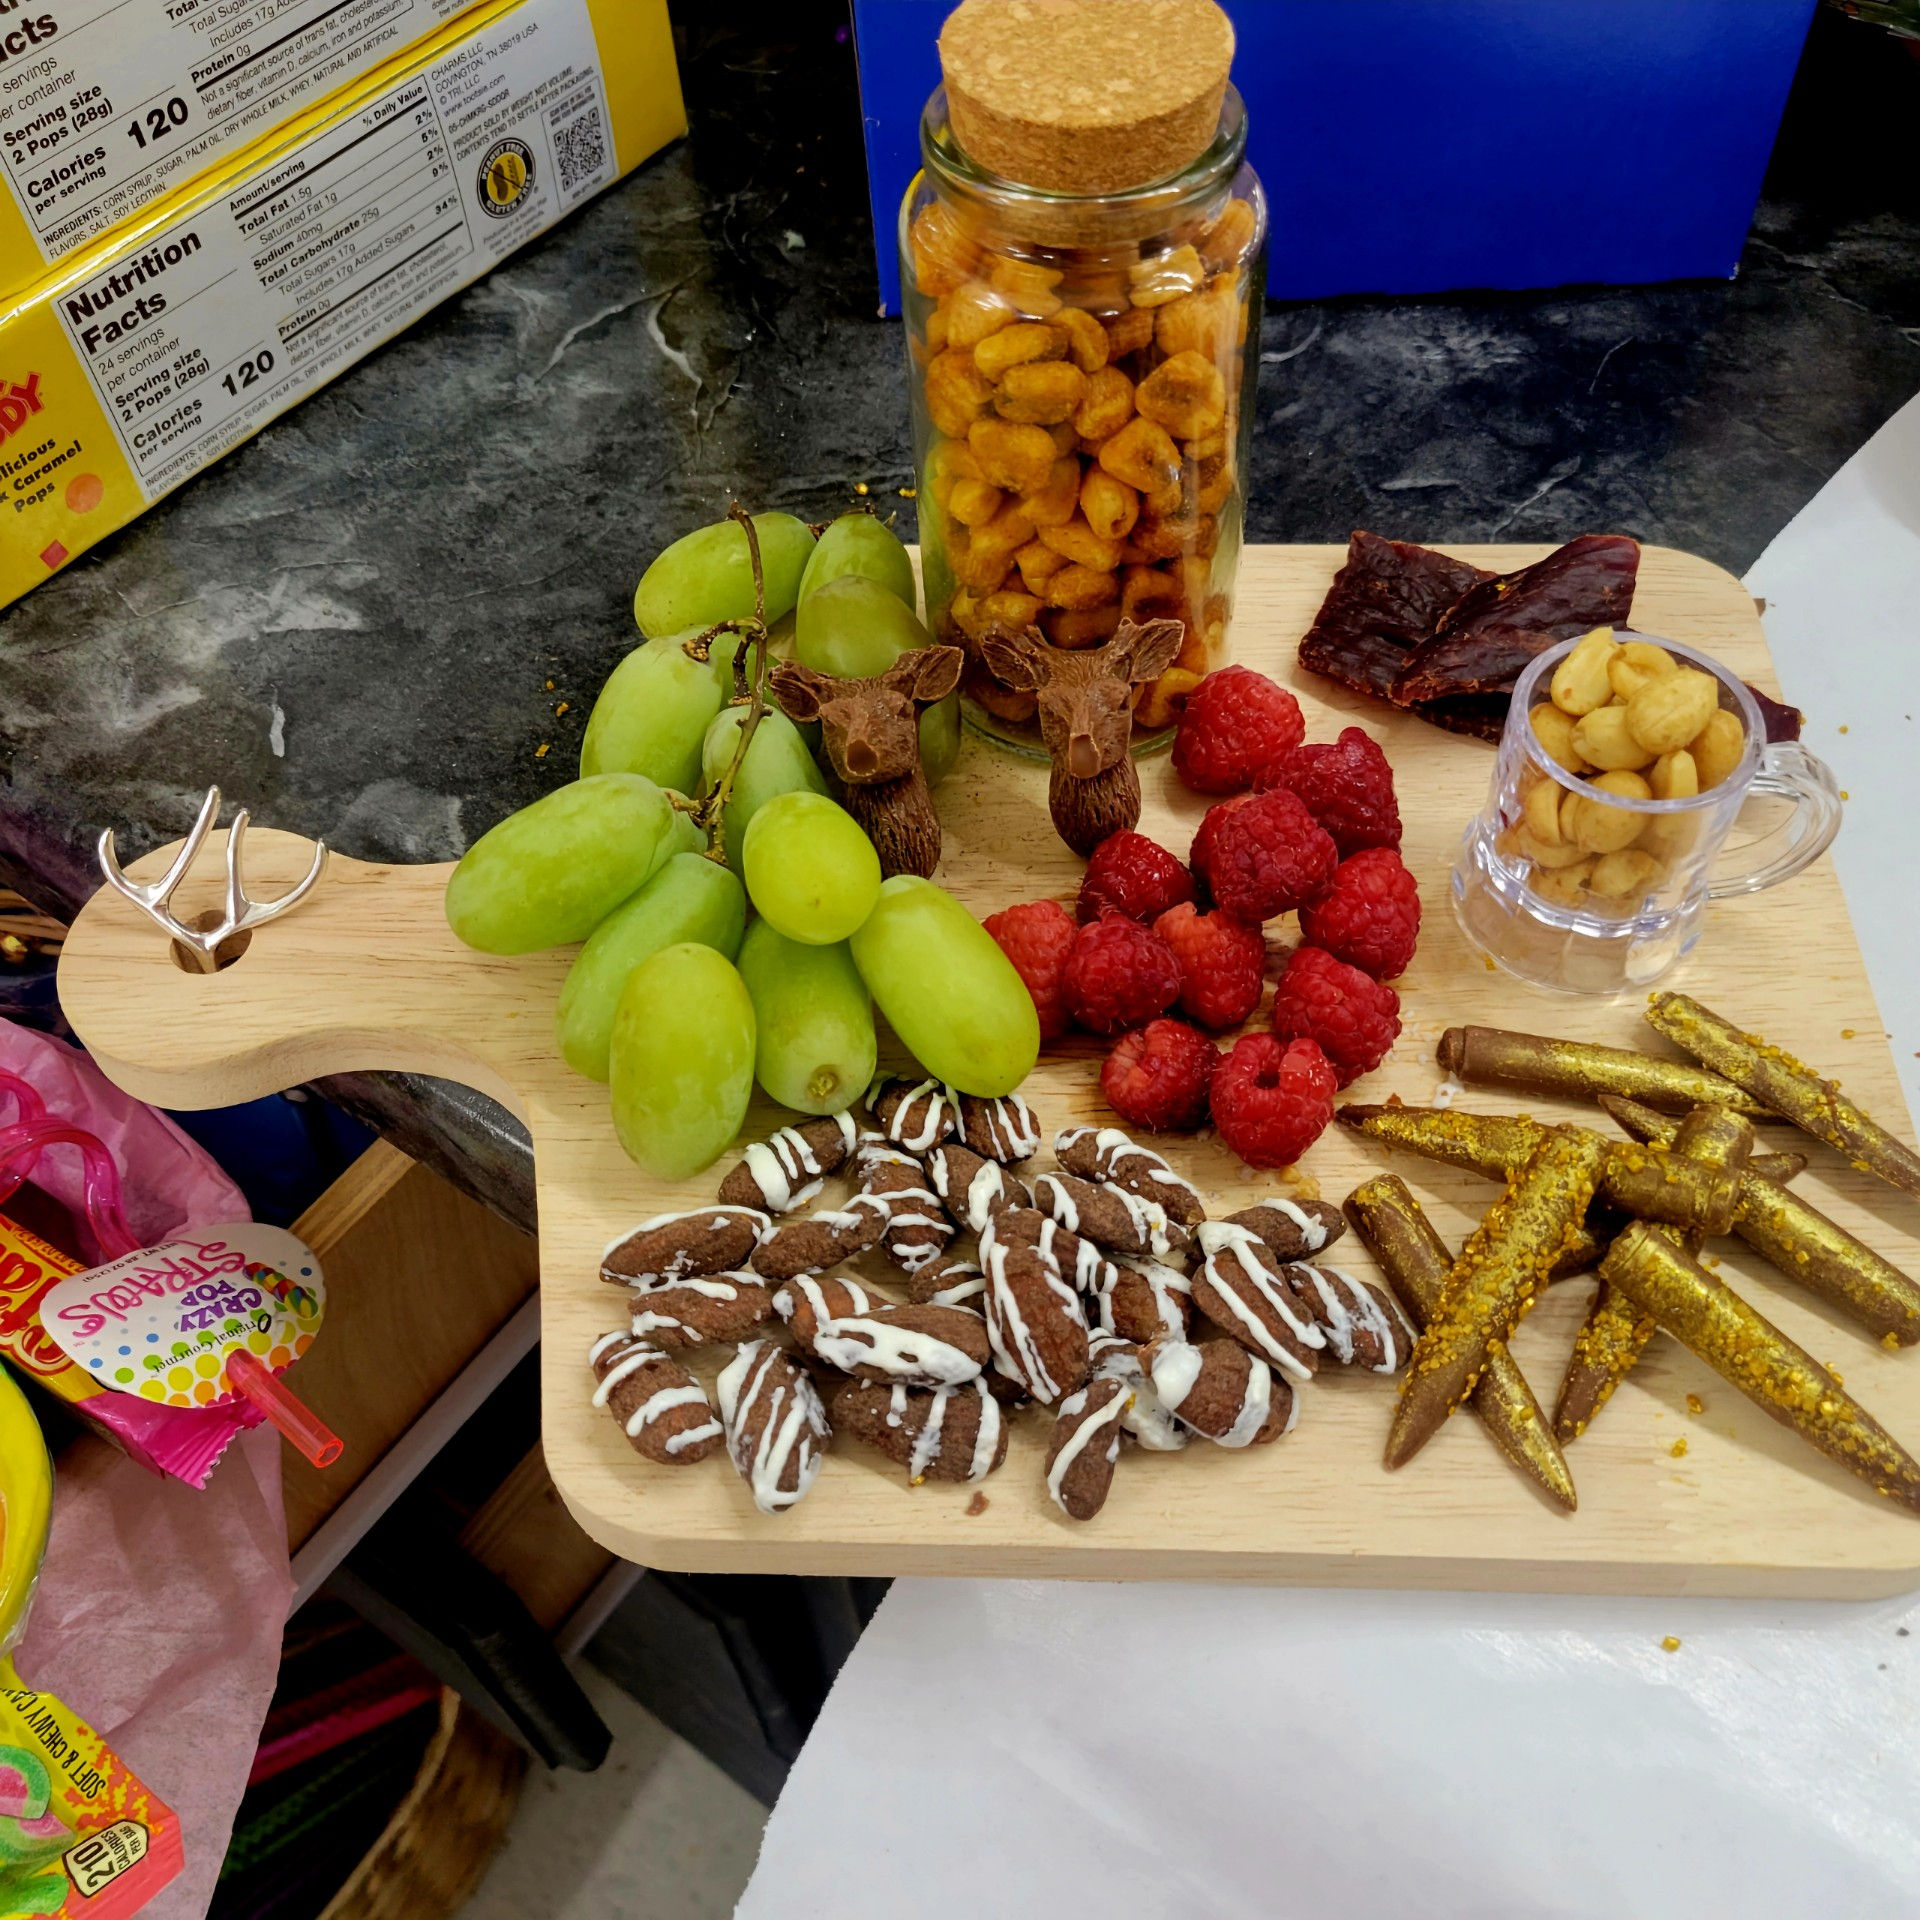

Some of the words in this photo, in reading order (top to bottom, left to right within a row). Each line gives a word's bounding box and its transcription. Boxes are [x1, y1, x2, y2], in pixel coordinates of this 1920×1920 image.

[166, 0, 199, 21] Total
[189, 15, 216, 34] Total
[218, 0, 250, 18] Sugar
[210, 20, 253, 47] Includes
[255, 7, 275, 23] 17g
[3, 57, 57, 93] servings
[191, 53, 235, 83] Protein
[236, 43, 250, 58] 0g
[201, 90, 217, 106] Not
[219, 87, 225, 96] a
[226, 62, 267, 92] significant
[268, 48, 294, 67] source
[295, 36, 305, 50] of
[305, 29, 325, 45] trans
[207, 99, 235, 120] dietary
[258, 66, 287, 88] vitamin
[331, 33, 347, 47] iron
[348, 21, 362, 37] and
[432, 53, 467, 81] CHARMS
[468, 42, 484, 60] LLC
[435, 59, 486, 93] COVINGTON,
[486, 49, 498, 61] TN
[499, 33, 521, 53] 38019
[522, 23, 539, 39] USA
[465, 74, 481, 89] LLC
[18, 70, 76, 110] container
[4, 106, 66, 147] Serving
[70, 86, 101, 110] size
[13, 150, 25, 164] 2
[27, 126, 68, 155] Pops
[72, 98, 112, 132] (28g)
[43, 205, 103, 246] INGREDIENTS:
[103, 190, 125, 210] CORN
[127, 174, 156, 196] SYRUP,
[156, 156, 185, 178] SUGAR,
[186, 139, 208, 160] PALM
[225, 123, 241, 137] DRY
[241, 103, 268, 126] WHOLE
[289, 78, 314, 97] WHEY,
[313, 57, 350, 83] NATURAL
[347, 45, 362, 61] AND
[363, 25, 399, 51] ARTIFICIAL
[28, 146, 106, 198] Calories
[128, 97, 188, 149] 120
[229, 159, 306, 212] Amount/serving
[363, 115, 373, 127] %
[374, 102, 397, 121] Daily
[397, 86, 423, 105] Value
[239, 215, 269, 235] Total
[270, 199, 290, 216] Fat
[290, 185, 312, 204] 1.5g
[415, 109, 432, 125] 2%
[35, 194, 56, 214] per
[61, 166, 106, 198] serving
[254, 241, 295, 270] Sodium
[296, 222, 323, 243] 40mg
[427, 144, 444, 160] 2%
[260, 210, 306, 245] Saturated
[307, 198, 324, 216] Fat
[325, 191, 338, 205] 1g
[422, 127, 438, 143] 5%
[49, 231, 90, 259] FLAVORS,
[113, 206, 130, 221] SOY
[259, 267, 288, 287] Total
[291, 219, 360, 268] Carbohydrate
[361, 205, 380, 223] 25g
[432, 162, 448, 177] 9%
[279, 279, 303, 296] Total
[304, 256, 337, 281] Sugars
[338, 243, 356, 258] 17g
[296, 278, 335, 306] Includes
[336, 264, 353, 279] 17g
[355, 246, 384, 267] Added
[385, 224, 415, 248] Sugars
[435, 195, 458, 215] 34%
[66, 232, 202, 325] Nutrition
[81, 293, 167, 355] Facts
[278, 308, 317, 336] Protein
[318, 298, 331, 312] 0g
[99, 356, 116, 375] 24
[117, 328, 165, 365] servings
[107, 374, 126, 393] per
[129, 336, 180, 376] container
[115, 369, 171, 408] Serving
[173, 348, 202, 371] size
[122, 408, 134, 422] 2
[135, 387, 172, 413] Pops
[175, 358, 210, 389] (28g)
[133, 399, 203, 449] Calories
[221, 350, 275, 397] 120
[0, 438, 56, 481] licious
[139, 445, 159, 462] per
[161, 414, 202, 446] serving
[13, 440, 83, 492] Caramel
[13, 481, 56, 513] Pops
[58, 1240, 246, 1338] STRAWS
[179, 1287, 262, 1333] CRAZY
[180, 1279, 236, 1307] POP
[214, 1313, 272, 1348] Original
[151, 1341, 213, 1375] Gourmet
[24, 1705, 68, 1760] CHEWY
[61, 1751, 79, 1769] &
[68, 1760, 106, 1799] SOFT
[100, 1830, 130, 1871] CALORIES
[119, 1825, 136, 1840] BAG
[130, 1836, 142, 1856] PER
[73, 1841, 115, 1888] 210
